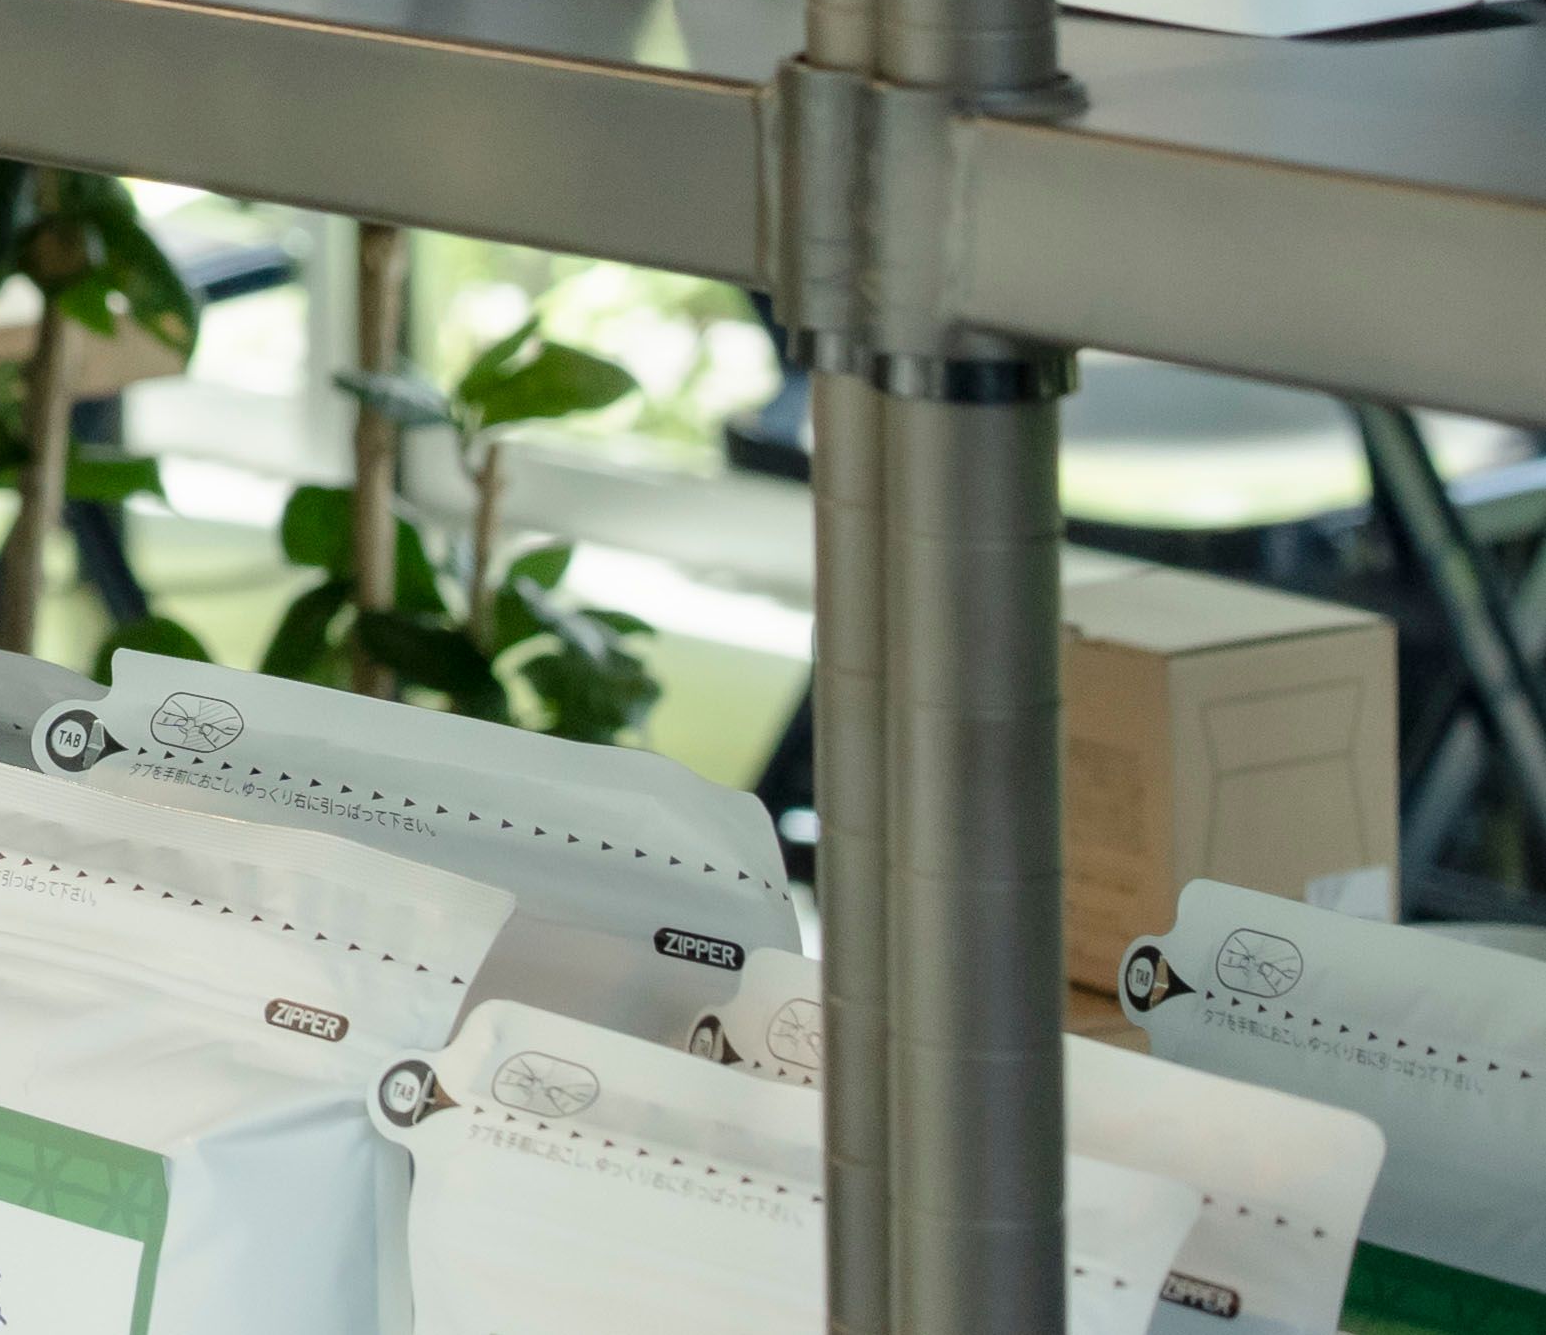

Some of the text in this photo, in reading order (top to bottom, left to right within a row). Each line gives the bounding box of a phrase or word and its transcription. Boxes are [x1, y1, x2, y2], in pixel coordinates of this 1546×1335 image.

[58, 727, 82, 749] TAB
[663, 932, 739, 970] ZIPPER
[271, 1000, 342, 1039] ZIPPER
